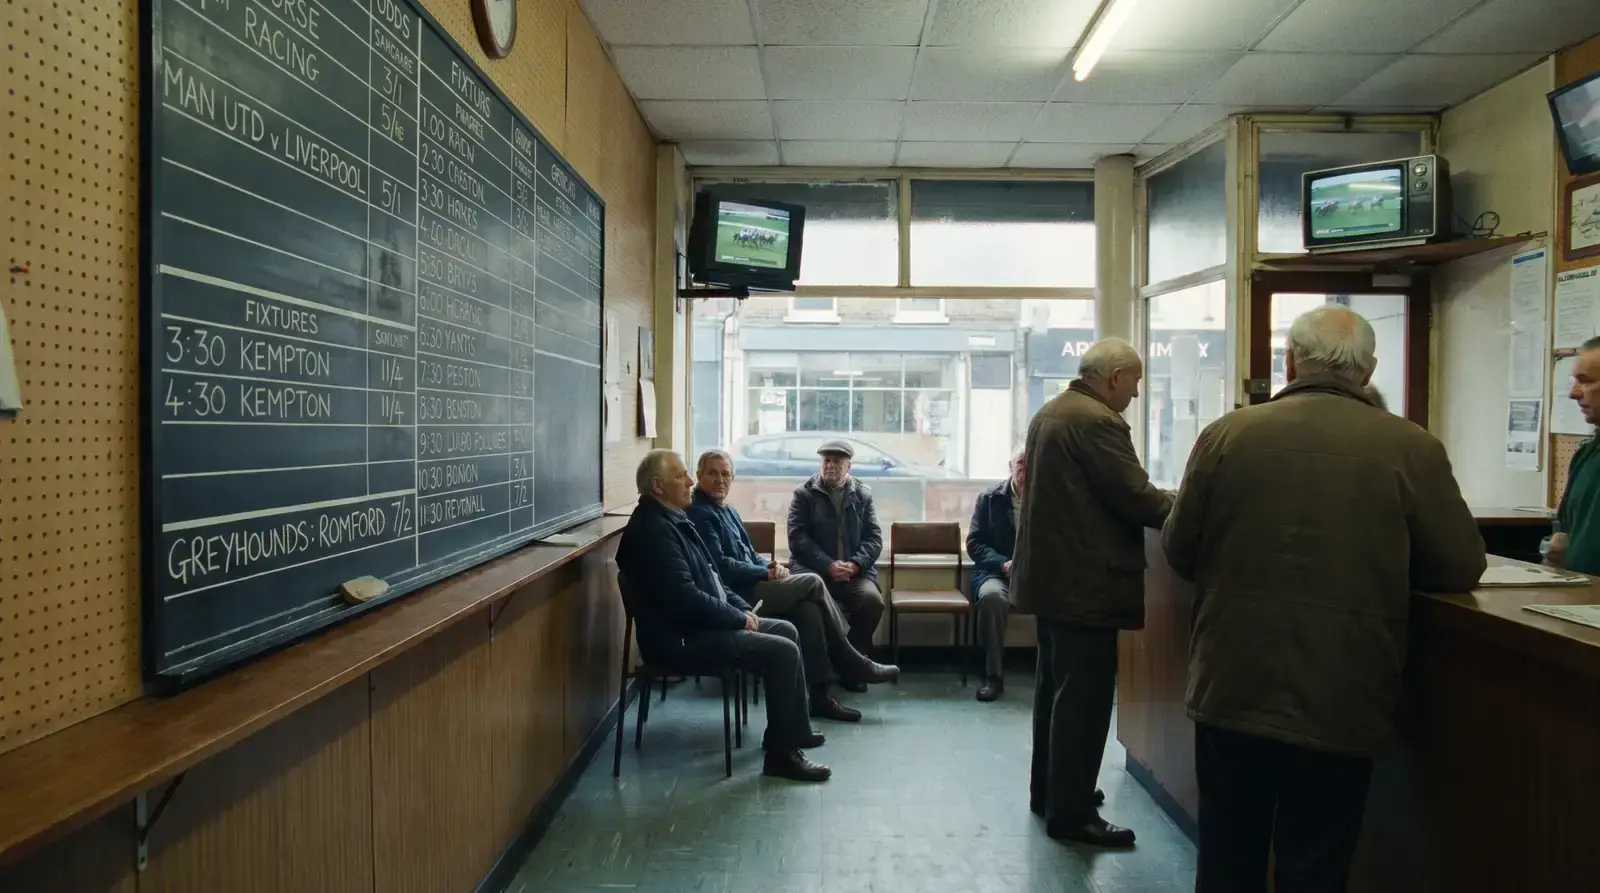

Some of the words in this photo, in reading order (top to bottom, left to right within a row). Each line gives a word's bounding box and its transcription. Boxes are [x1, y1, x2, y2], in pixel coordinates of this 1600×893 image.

[271, 0, 320, 39] RSE
[377, 0, 410, 39] ODDS
[245, 7, 320, 81] RACING
[382, 66, 402, 105] 3/1
[163, 60, 215, 120] MAN
[223, 96, 265, 142] UTD
[285, 128, 367, 195] LIVERPOOL
[381, 180, 402, 218] 5/1
[421, 178, 444, 210] 3:30
[420, 250, 444, 281] 5:30
[246, 300, 318, 334] FIXTURES
[166, 325, 226, 366] 3:30
[241, 337, 330, 377] KEMPTON
[382, 356, 404, 389] 11/4
[420, 360, 442, 384] 7:30
[165, 378, 226, 416] 4:30
[241, 384, 331, 418] KEMPTON
[382, 392, 404, 424] 11/4
[419, 396, 442, 420] 8:30
[419, 432, 442, 455] 9:30
[420, 502, 442, 527] 11:30
[168, 521, 315, 584] GREYHOUNDS:
[319, 507, 386, 548] ROMFORD
[391, 497, 413, 537] 7/2
